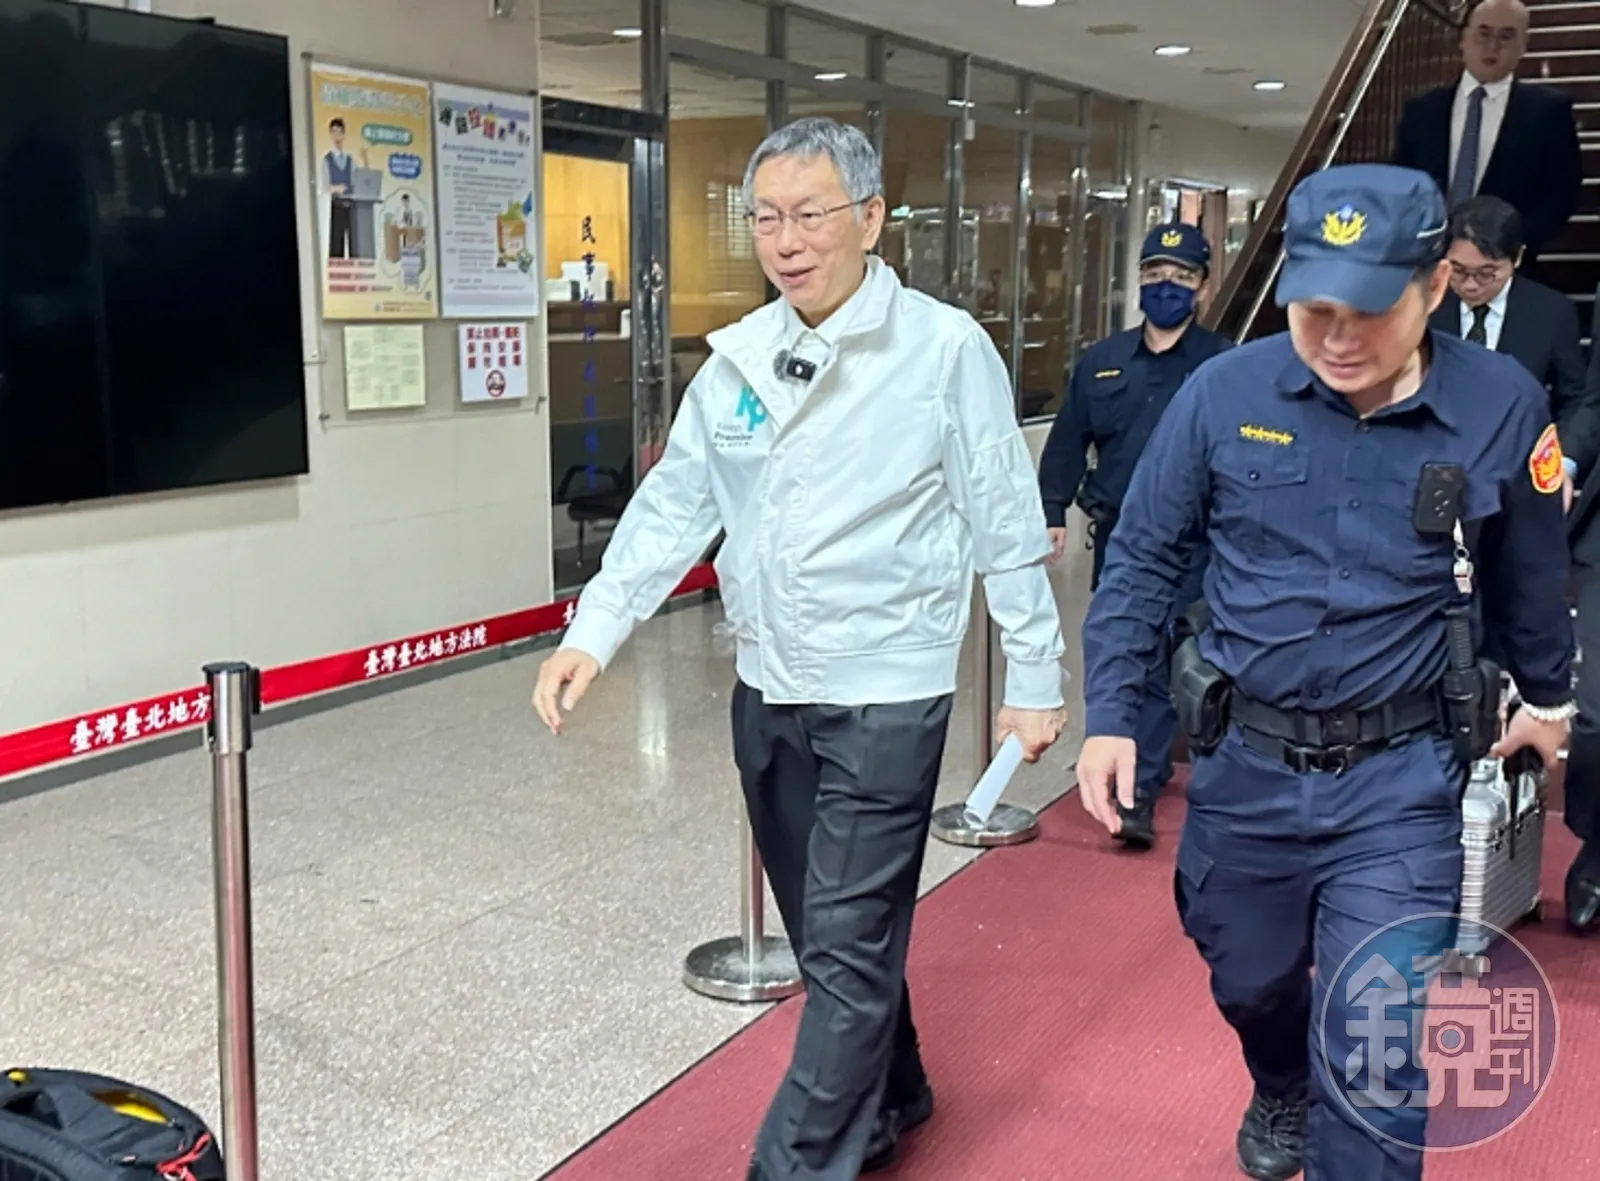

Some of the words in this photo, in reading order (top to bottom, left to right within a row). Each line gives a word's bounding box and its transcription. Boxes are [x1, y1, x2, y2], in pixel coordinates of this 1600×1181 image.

[364, 624, 487, 678] 臺灣臺北地方法院
